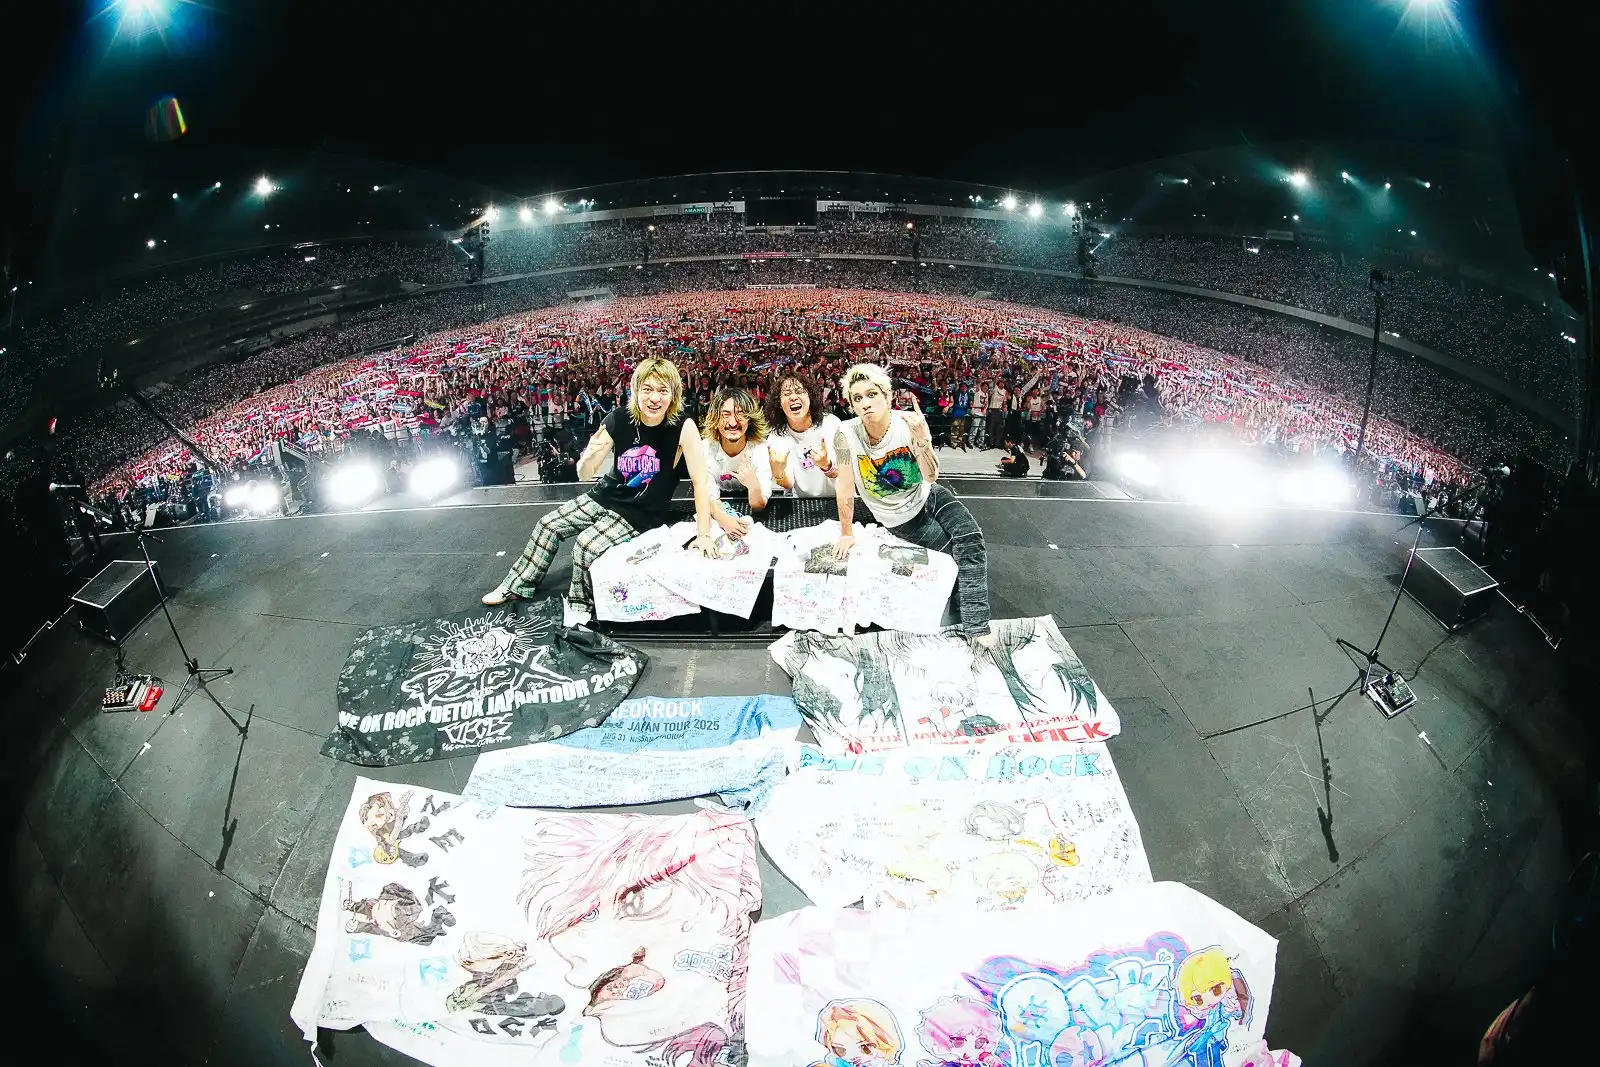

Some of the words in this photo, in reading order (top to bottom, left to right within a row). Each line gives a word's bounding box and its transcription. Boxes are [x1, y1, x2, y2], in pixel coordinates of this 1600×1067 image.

[623, 602, 656, 613] IBUKI
[359, 713, 384, 733] OK
[383, 704, 428, 731] ROCK
[428, 698, 485, 724] DETOX
[486, 687, 539, 716] JAPAN
[537, 679, 591, 704] TOUR
[591, 656, 639, 694] 2025
[627, 720, 660, 733] JAPAN
[663, 720, 691, 732] TOUR
[694, 718, 720, 731] 2025
[618, 733, 626, 741] 31
[903, 755, 975, 781] OK
[985, 752, 1102, 781] ROCK
